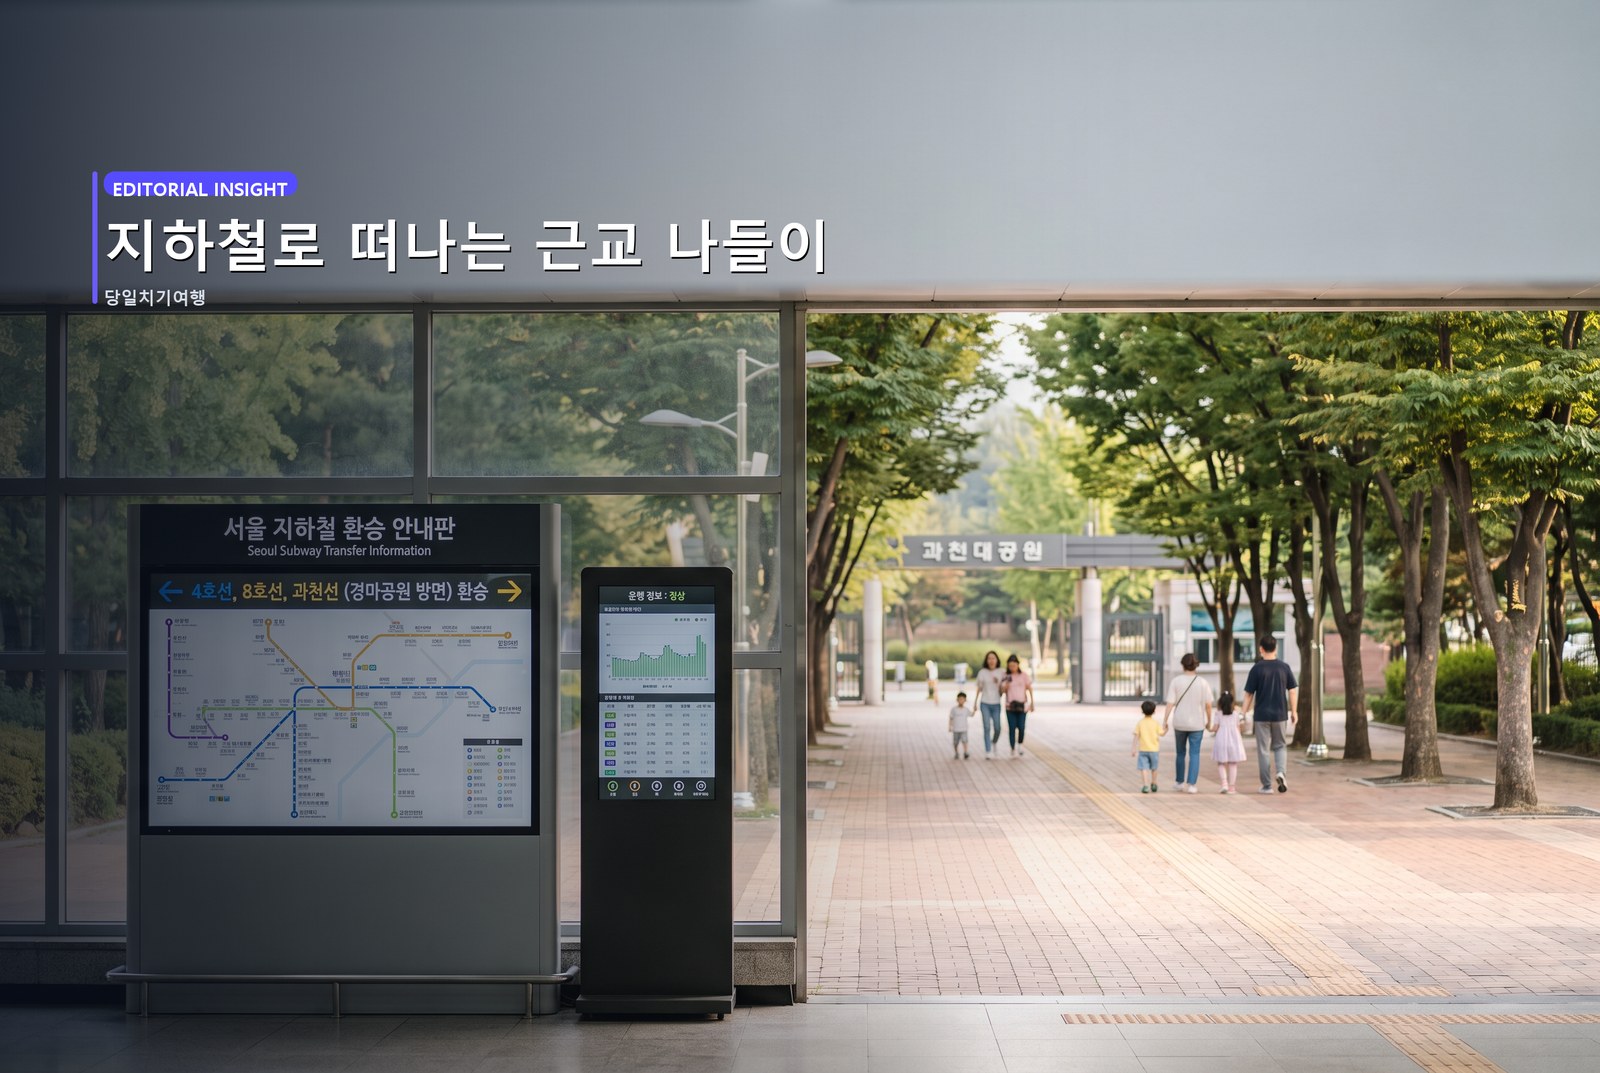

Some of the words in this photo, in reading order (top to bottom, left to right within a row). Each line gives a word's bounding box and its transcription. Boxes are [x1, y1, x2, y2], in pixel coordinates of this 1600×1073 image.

[224, 516, 267, 541] 서울
[273, 516, 336, 541] 지하철
[342, 516, 386, 541] 환승
[392, 516, 456, 541] 안내판
[247, 545, 277, 557] Seoul
[280, 545, 322, 559] Subway
[324, 545, 367, 557] Transfer
[369, 545, 431, 557] Information
[922, 541, 1043, 562] 과천대공원
[191, 582, 237, 602] 4호선,
[242, 582, 288, 602] 8호선,
[292, 582, 339, 602] 과천선
[344, 581, 411, 602] (경마공원
[416, 581, 452, 602] 방면)
[457, 581, 489, 602] 환승
[646, 591, 663, 601] 정보
